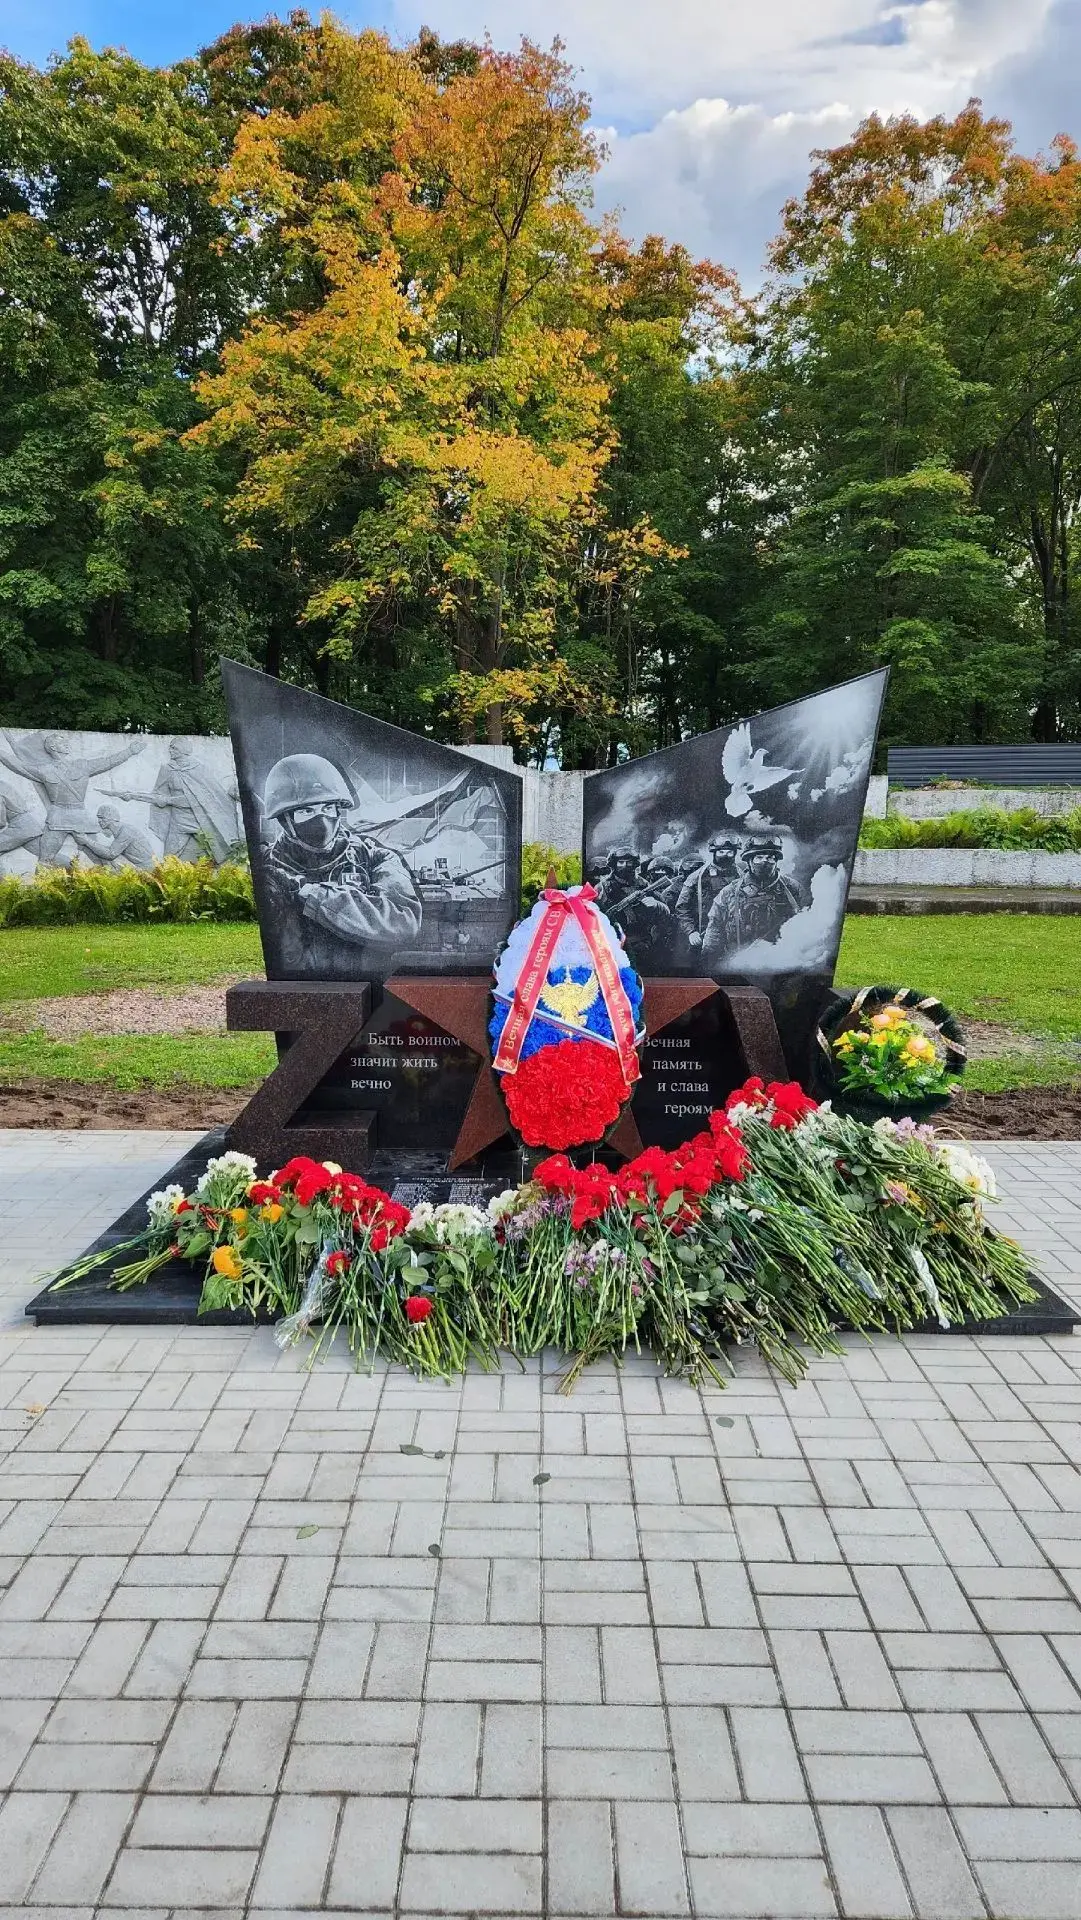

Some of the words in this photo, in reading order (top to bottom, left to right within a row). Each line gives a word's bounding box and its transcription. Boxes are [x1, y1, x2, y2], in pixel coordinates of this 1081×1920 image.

[503, 1005, 527, 1049] Вечная
[521, 968, 539, 1002] слава
[532, 929, 554, 969] героям
[546, 909, 562, 928] СВ
[368, 1032, 404, 1046] Быть
[408, 1036, 461, 1047] воином
[643, 1036, 691, 1048] Вечная
[350, 1057, 398, 1068] значит
[402, 1057, 438, 1068] жить
[652, 1060, 702, 1070] память
[350, 1079, 392, 1090] вечно
[657, 1082, 667, 1092] и
[670, 1082, 709, 1092] слава
[664, 1104, 714, 1118] героям
